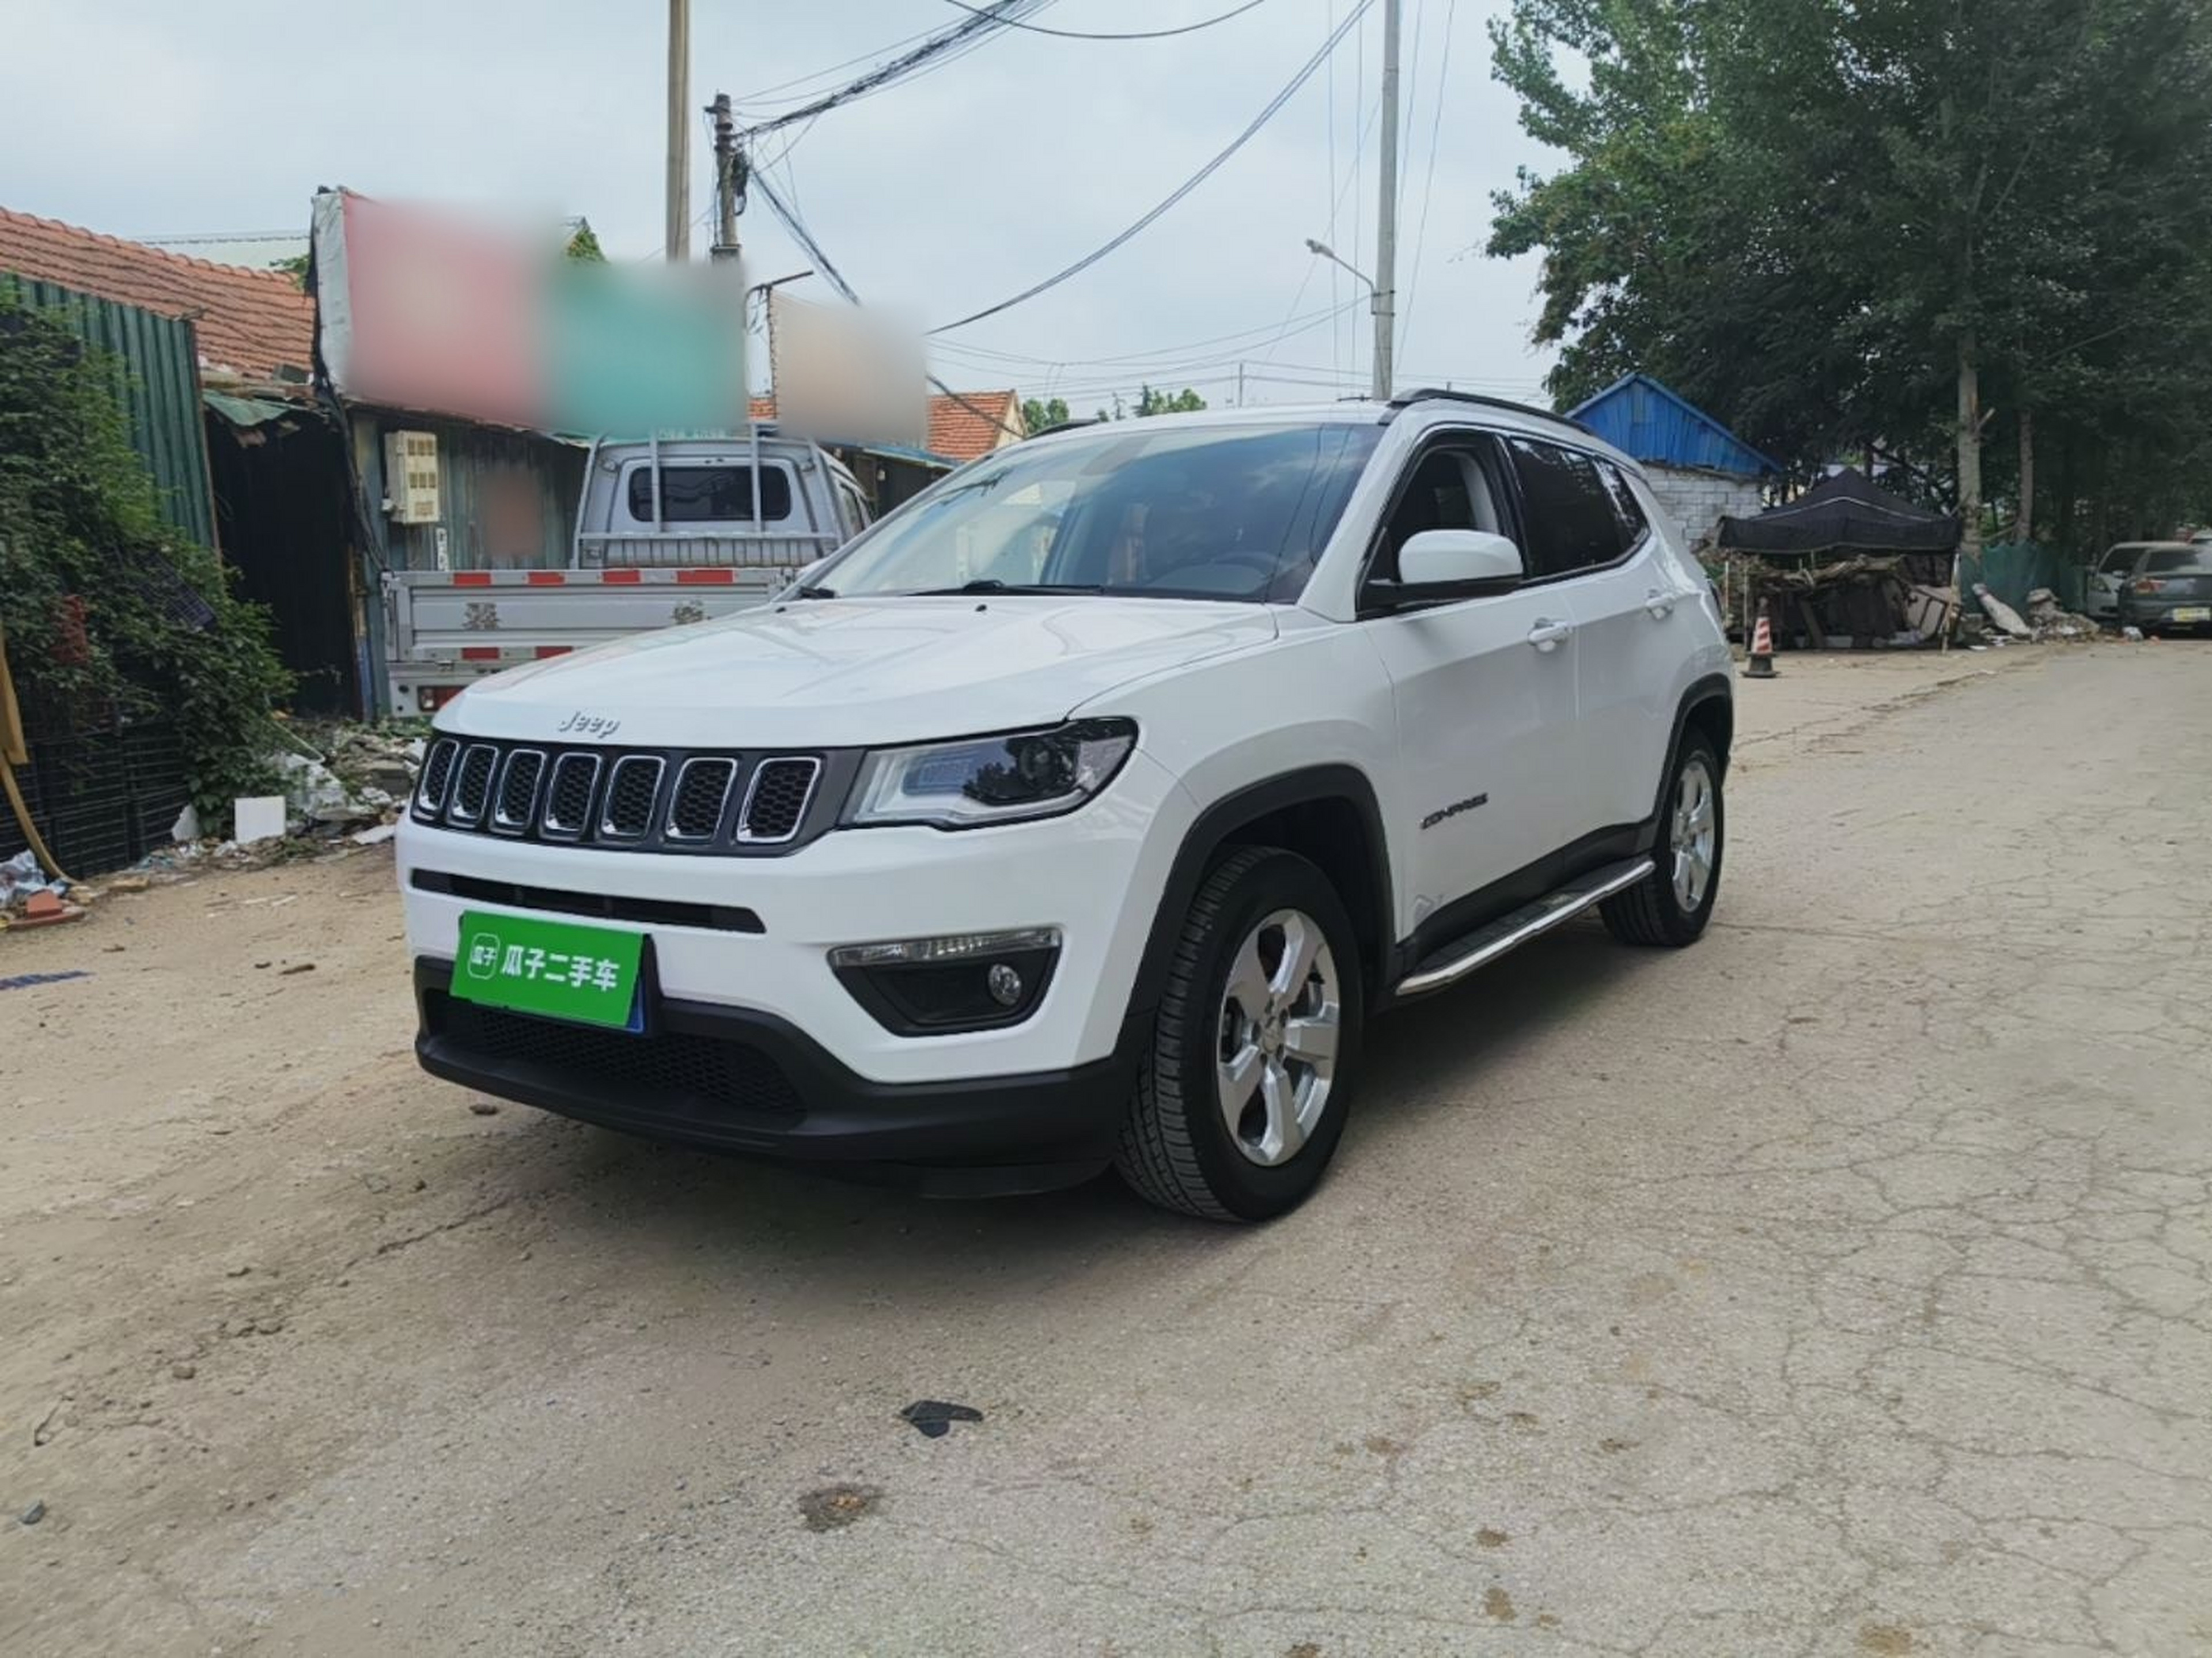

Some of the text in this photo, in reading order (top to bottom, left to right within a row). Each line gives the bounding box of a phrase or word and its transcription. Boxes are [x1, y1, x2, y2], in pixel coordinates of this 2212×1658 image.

[558, 711, 621, 739] Jeep
[502, 944, 620, 991] 瓜子二手车
